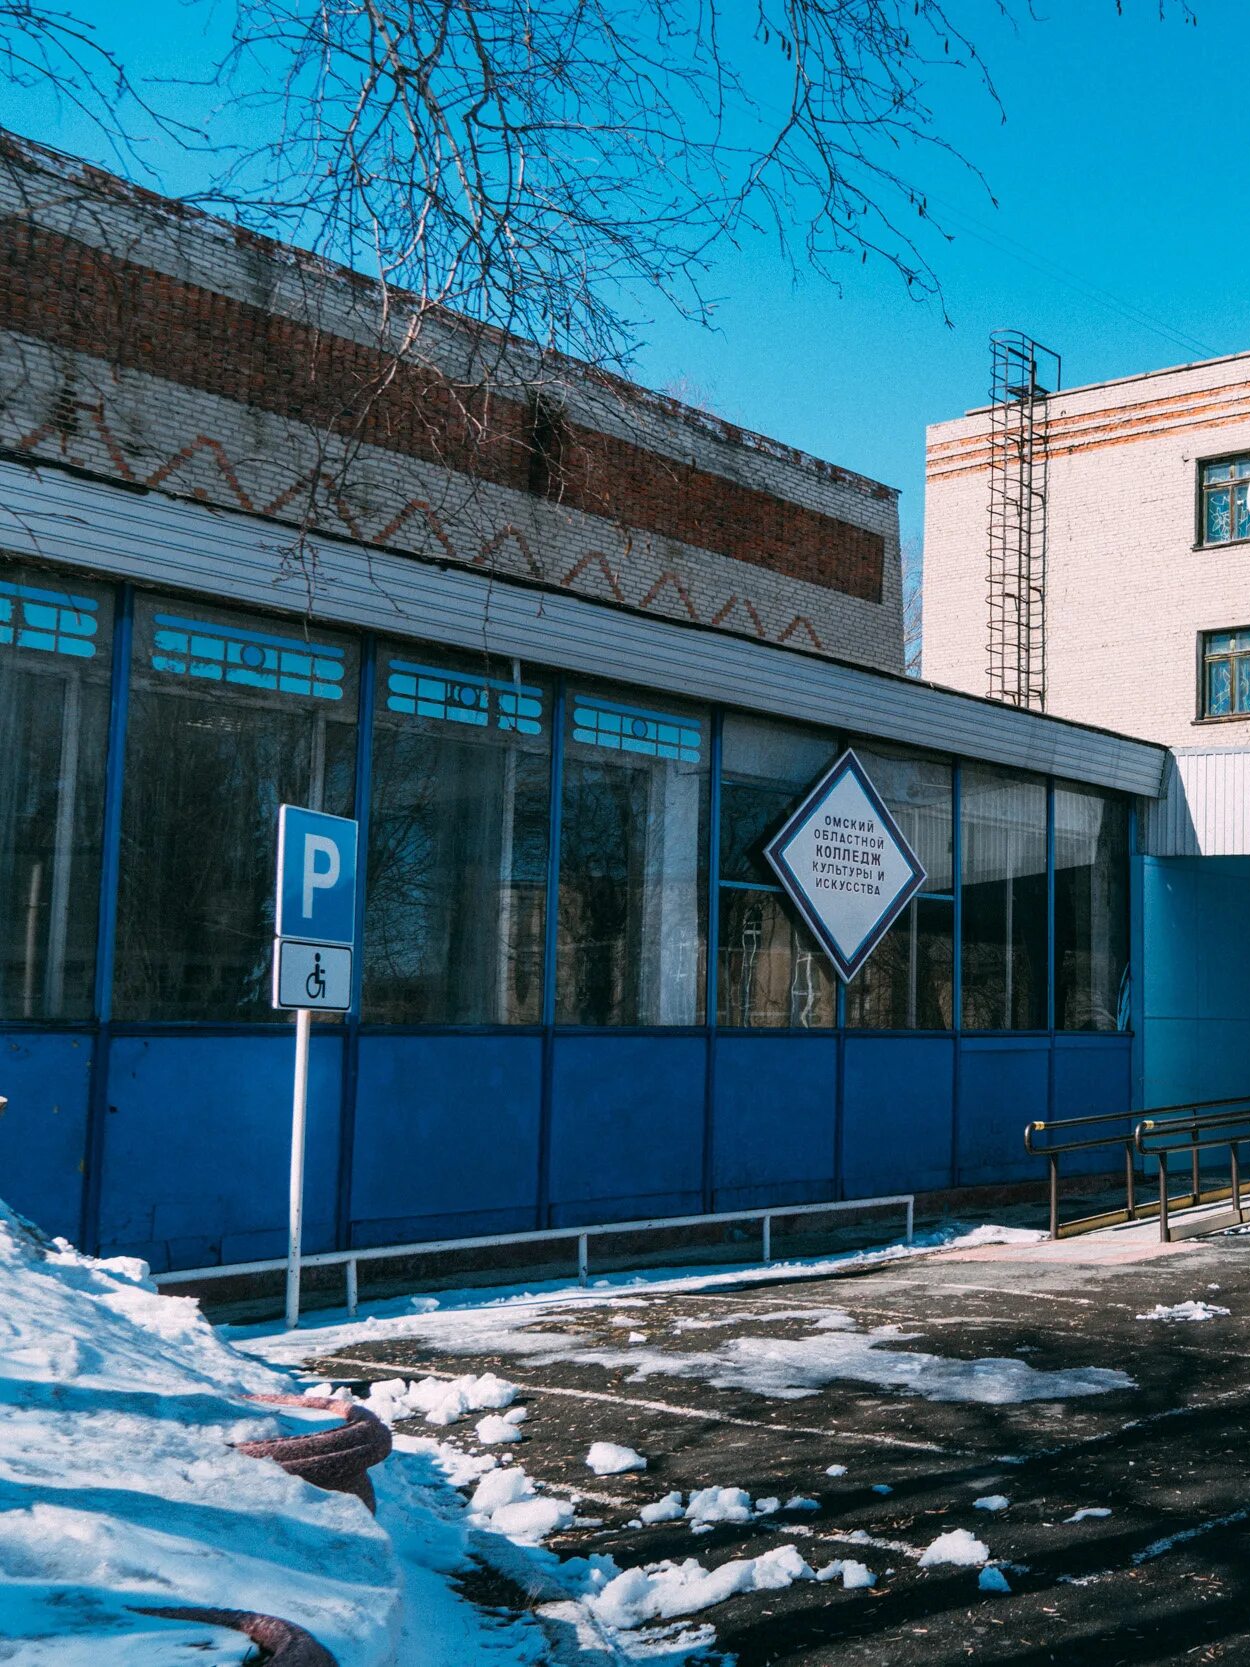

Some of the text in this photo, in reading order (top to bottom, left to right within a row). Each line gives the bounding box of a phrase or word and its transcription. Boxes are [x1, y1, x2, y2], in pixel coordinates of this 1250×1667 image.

[825, 816, 874, 833] ОМСКИЙ
[813, 828, 885, 850] ОБЛАСТНОЙ
[816, 844, 881, 866] КОЛЛЕДЖ
[302, 832, 341, 919] P
[812, 860, 885, 882] КУЛЬТУРЫ И
[815, 877, 881, 896] ИСКУССТВА
